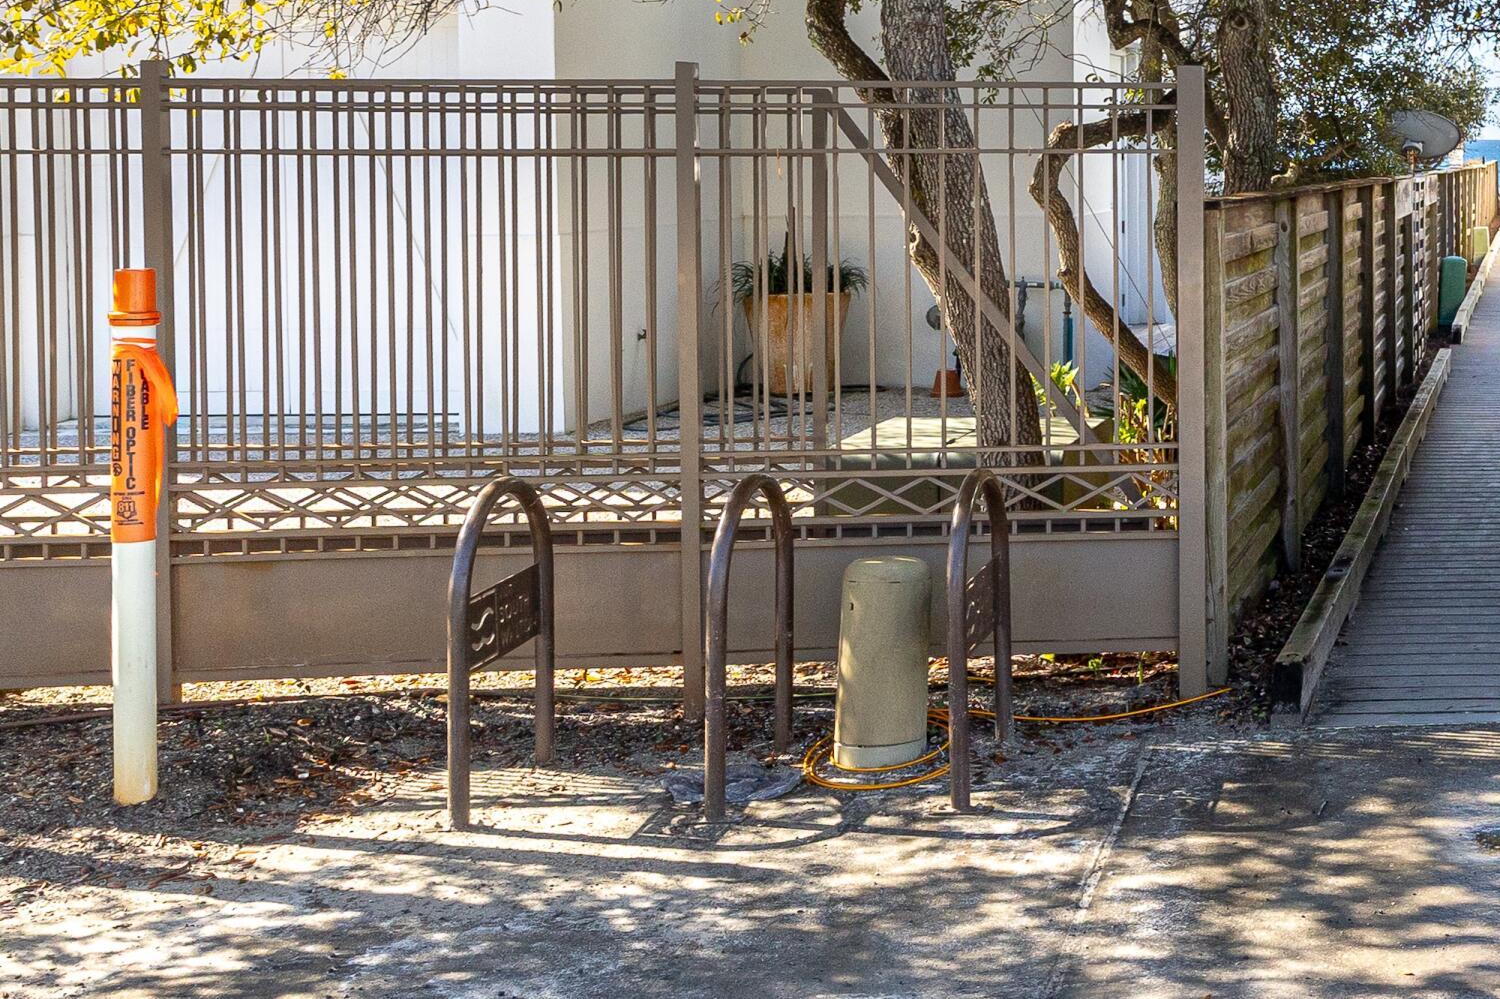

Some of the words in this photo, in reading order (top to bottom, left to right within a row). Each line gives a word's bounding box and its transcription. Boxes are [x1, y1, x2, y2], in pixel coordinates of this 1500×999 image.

[112, 360, 121, 461] WARNING
[126, 359, 136, 422] FIBER
[126, 427, 136, 489] OPTIC
